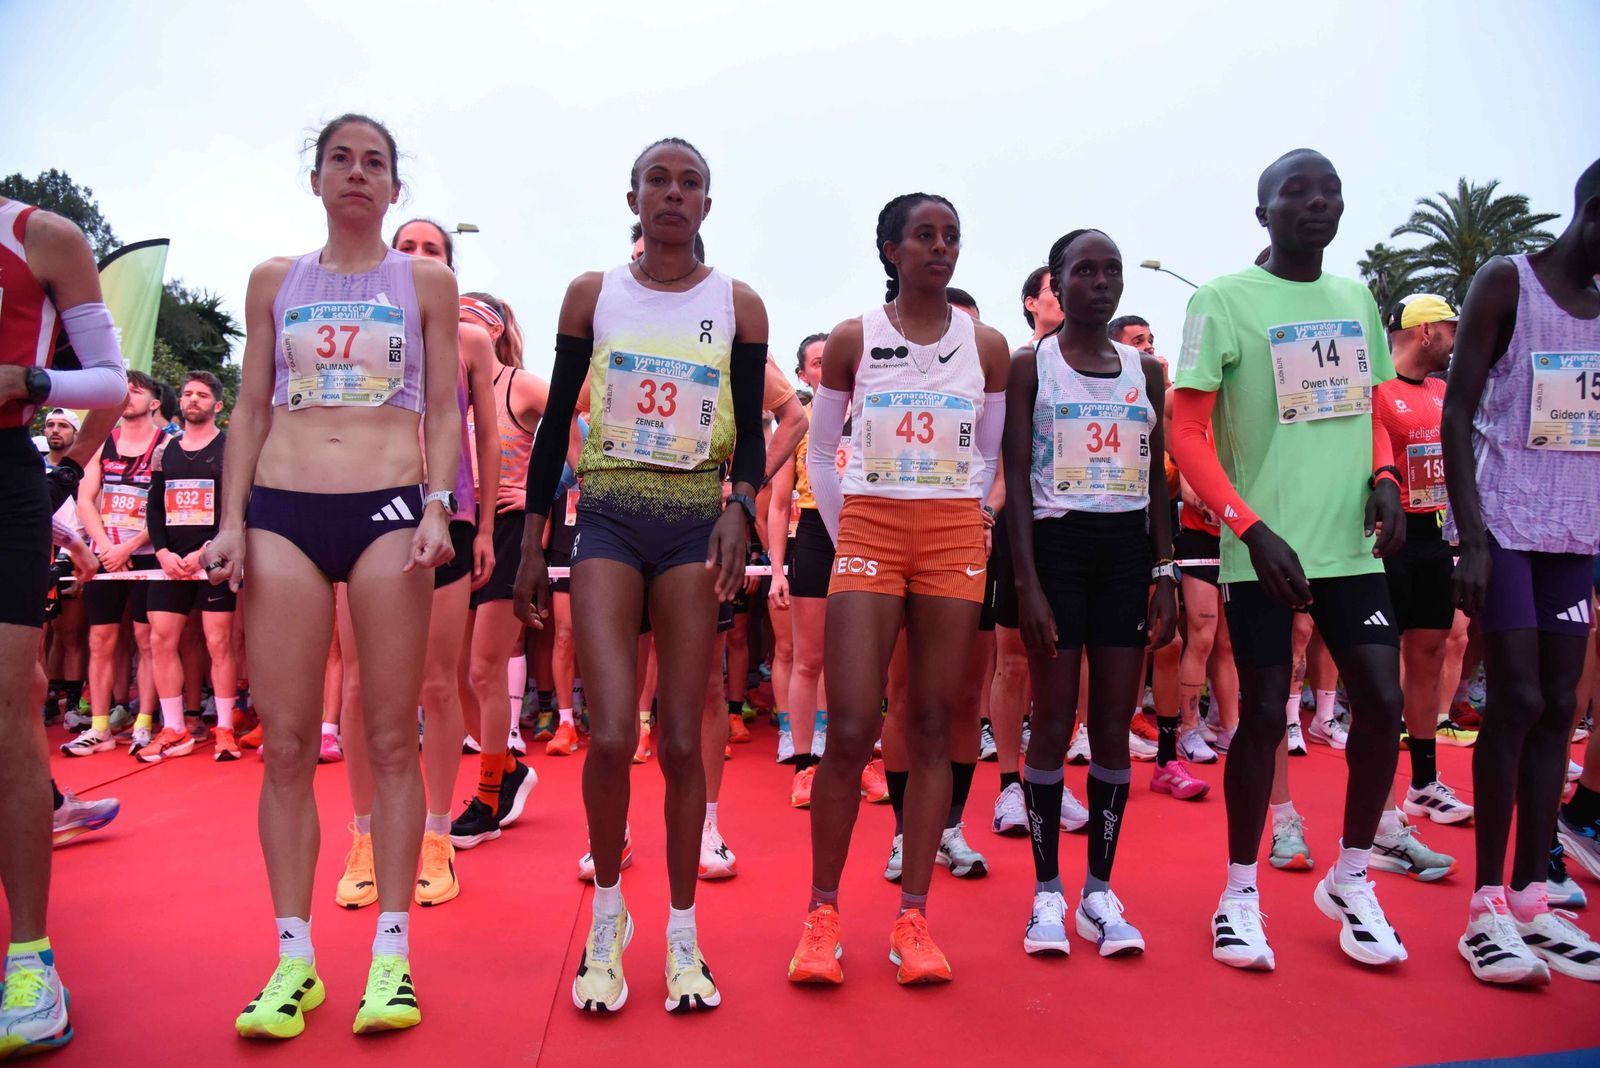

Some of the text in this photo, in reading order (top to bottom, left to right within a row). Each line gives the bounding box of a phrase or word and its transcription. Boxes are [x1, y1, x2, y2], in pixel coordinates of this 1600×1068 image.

[316, 324, 360, 359] 37
[1311, 339, 1341, 368] 14
[315, 363, 354, 371] GALIMANY
[655, 366, 686, 378] sevilla
[1301, 376, 1349, 390] Owen Korir
[1576, 371, 1600, 401] 15
[637, 379, 678, 417] 33
[1550, 409, 1586, 420] Gideon
[635, 417, 664, 429] ZEINEBA
[895, 410, 935, 445] 43
[1086, 422, 1121, 453] 34
[634, 448, 651, 456] HOKA
[111, 495, 136, 509] 988
[176, 490, 199, 505] 632
